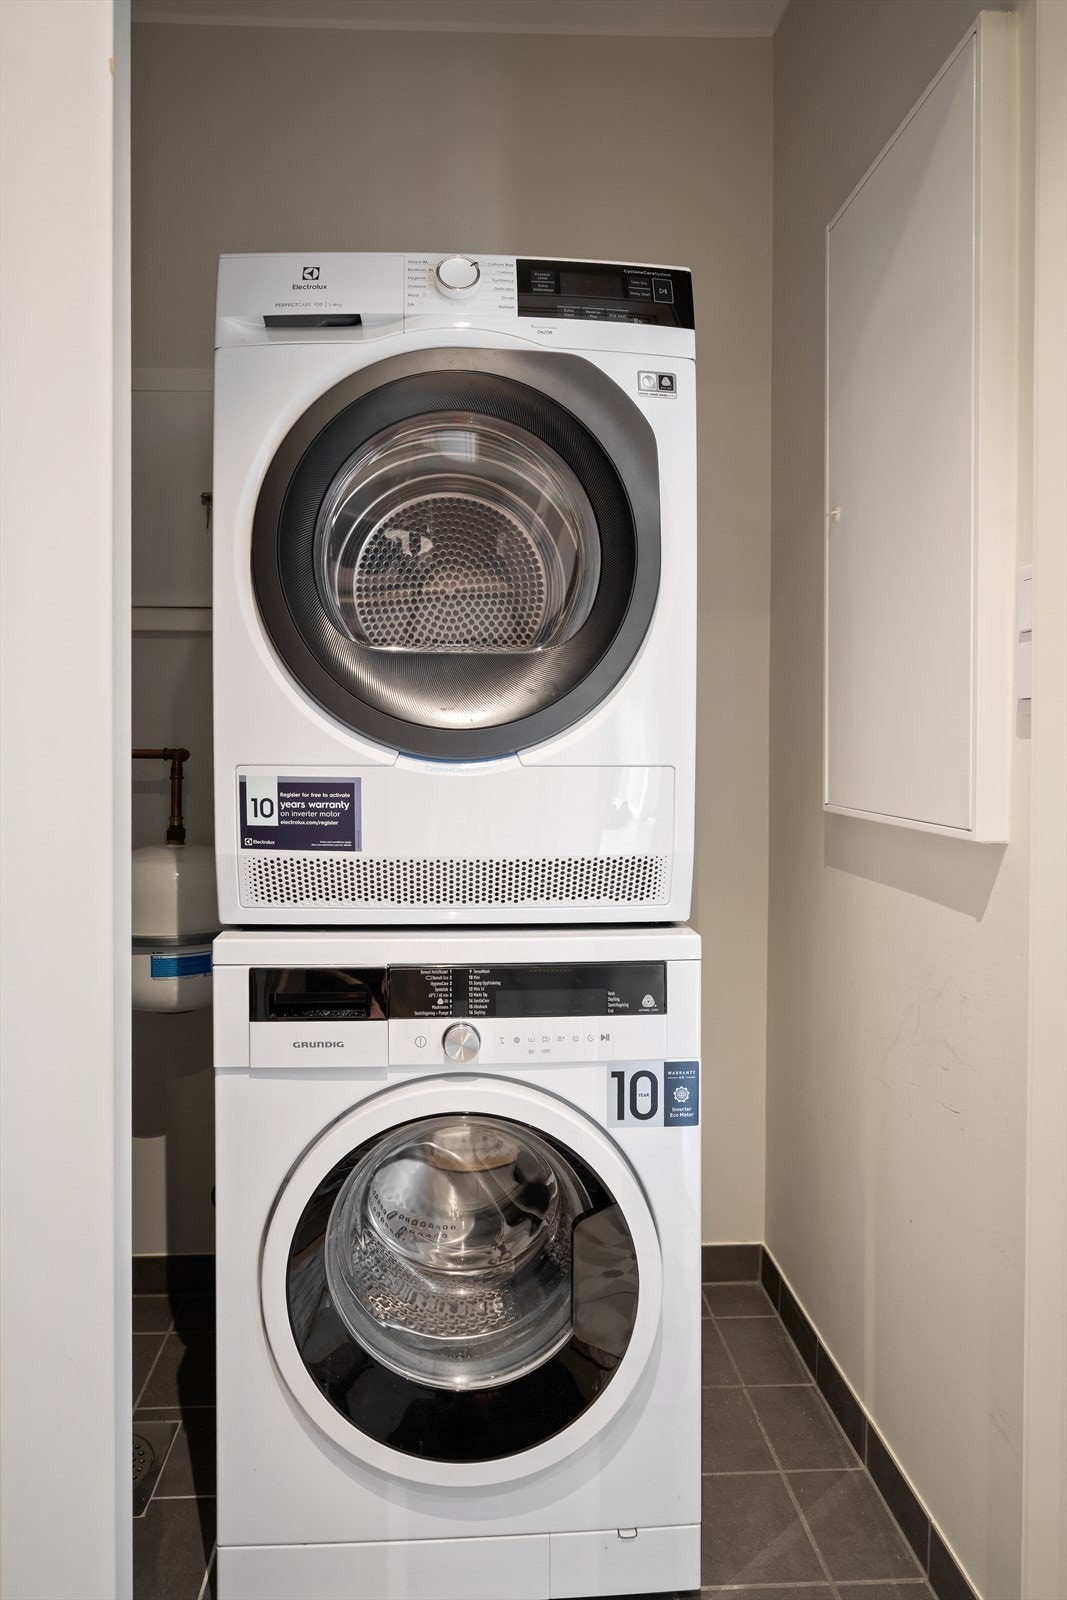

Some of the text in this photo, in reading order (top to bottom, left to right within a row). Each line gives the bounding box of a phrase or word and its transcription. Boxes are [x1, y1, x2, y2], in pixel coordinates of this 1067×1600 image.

[624, 268, 671, 277] CycloneCareSystem
[251, 797, 274, 818] 10
[280, 801, 350, 810] years warranty
[611, 1070, 658, 1120] 10
